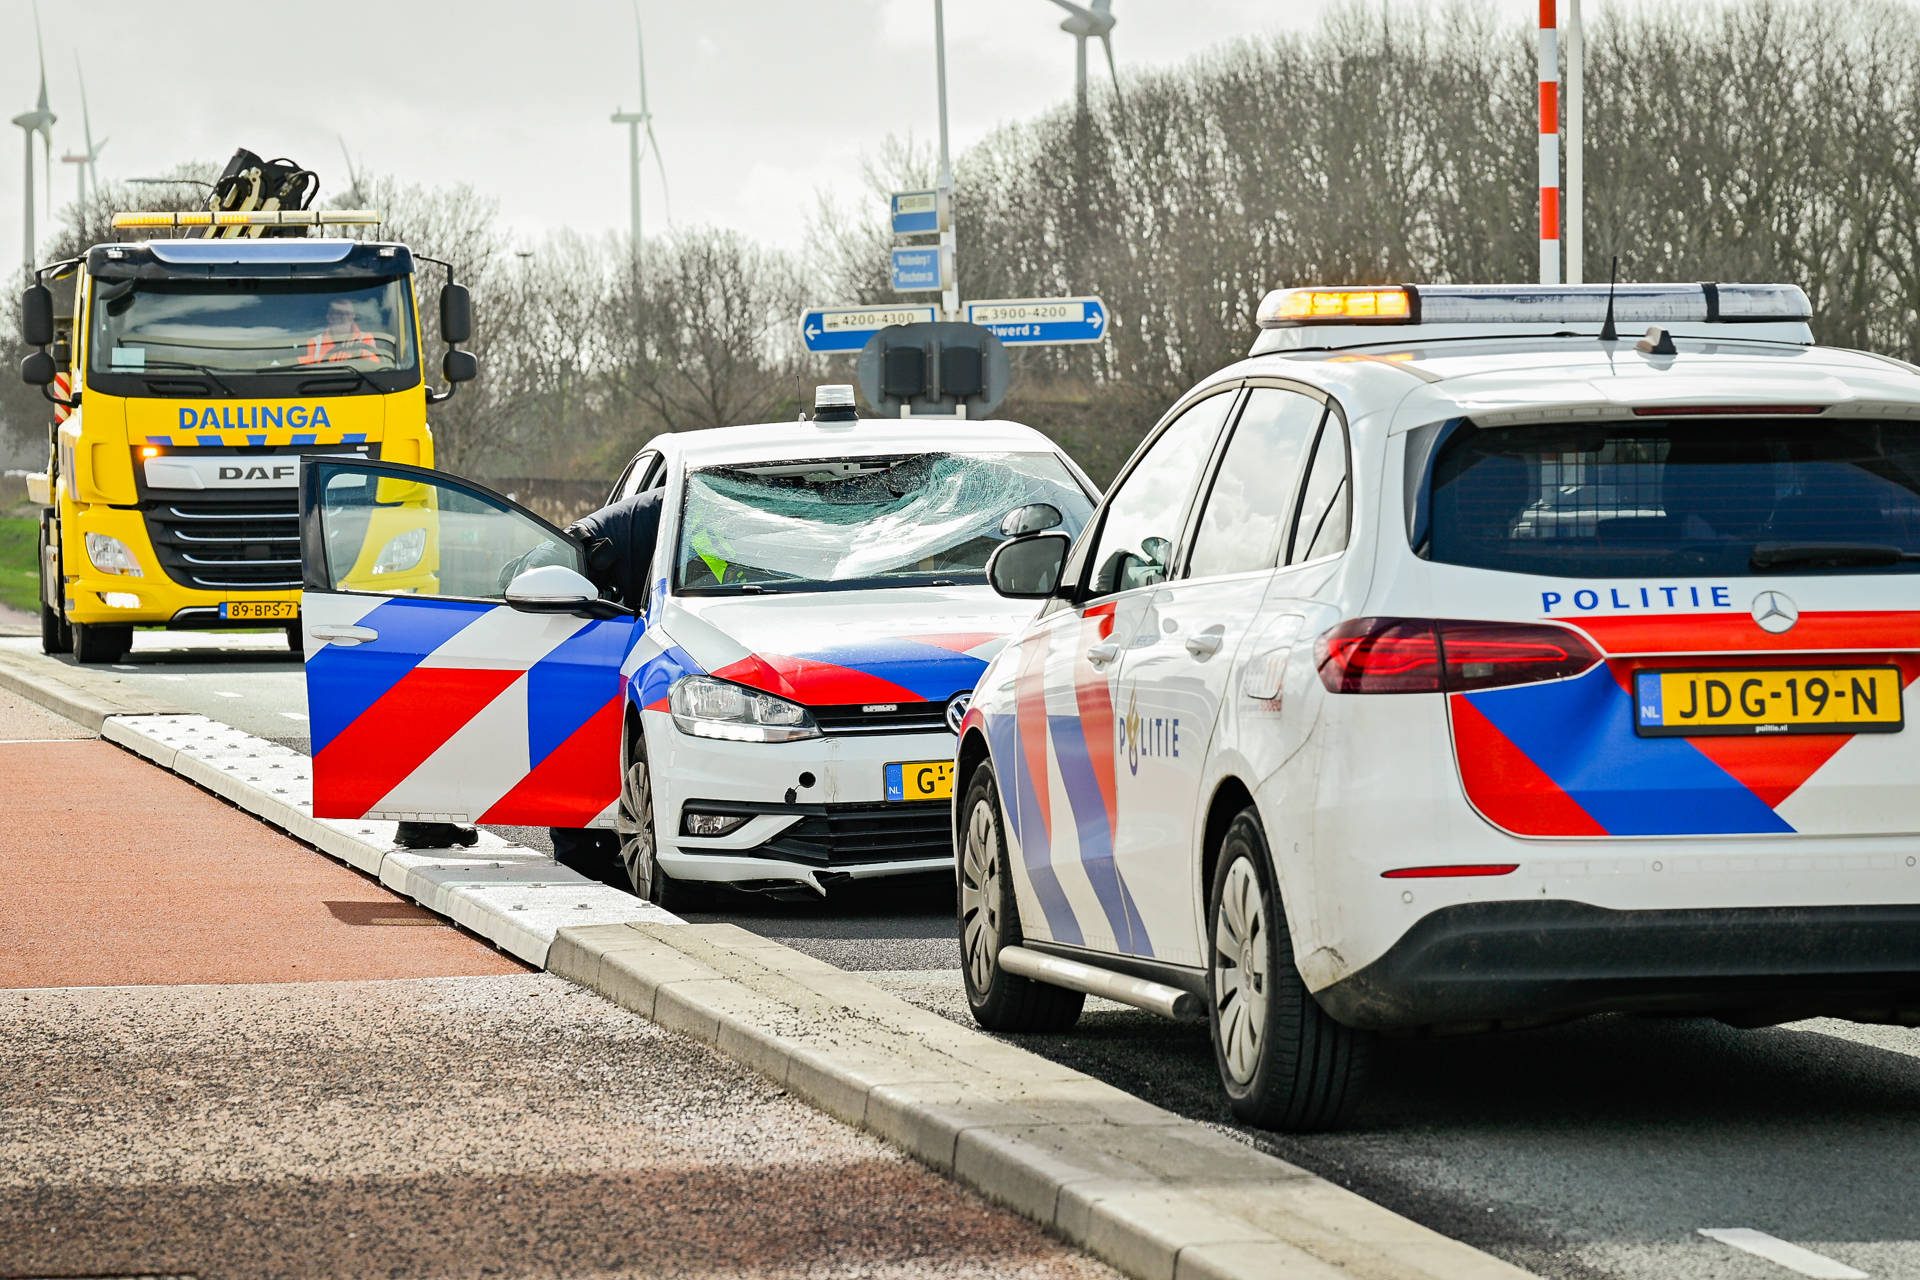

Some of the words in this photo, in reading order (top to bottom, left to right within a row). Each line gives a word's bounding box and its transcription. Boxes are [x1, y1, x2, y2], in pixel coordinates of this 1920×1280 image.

[842, 312, 915, 326] 4200-4300
[991, 306, 1067, 320] 3900-4200
[987, 324, 1030, 337] iwerd
[1033, 324, 1041, 336] 2
[179, 406, 331, 430] DALLINGA
[218, 466, 295, 480] DAF
[1541, 586, 1732, 613] POLITIE
[231, 604, 293, 617] 89-BPS-7
[1640, 705, 1661, 719] NL
[1679, 676, 1878, 719] JDG-19-N
[1119, 716, 1179, 776] POLITIE
[888, 786, 902, 795] NL
